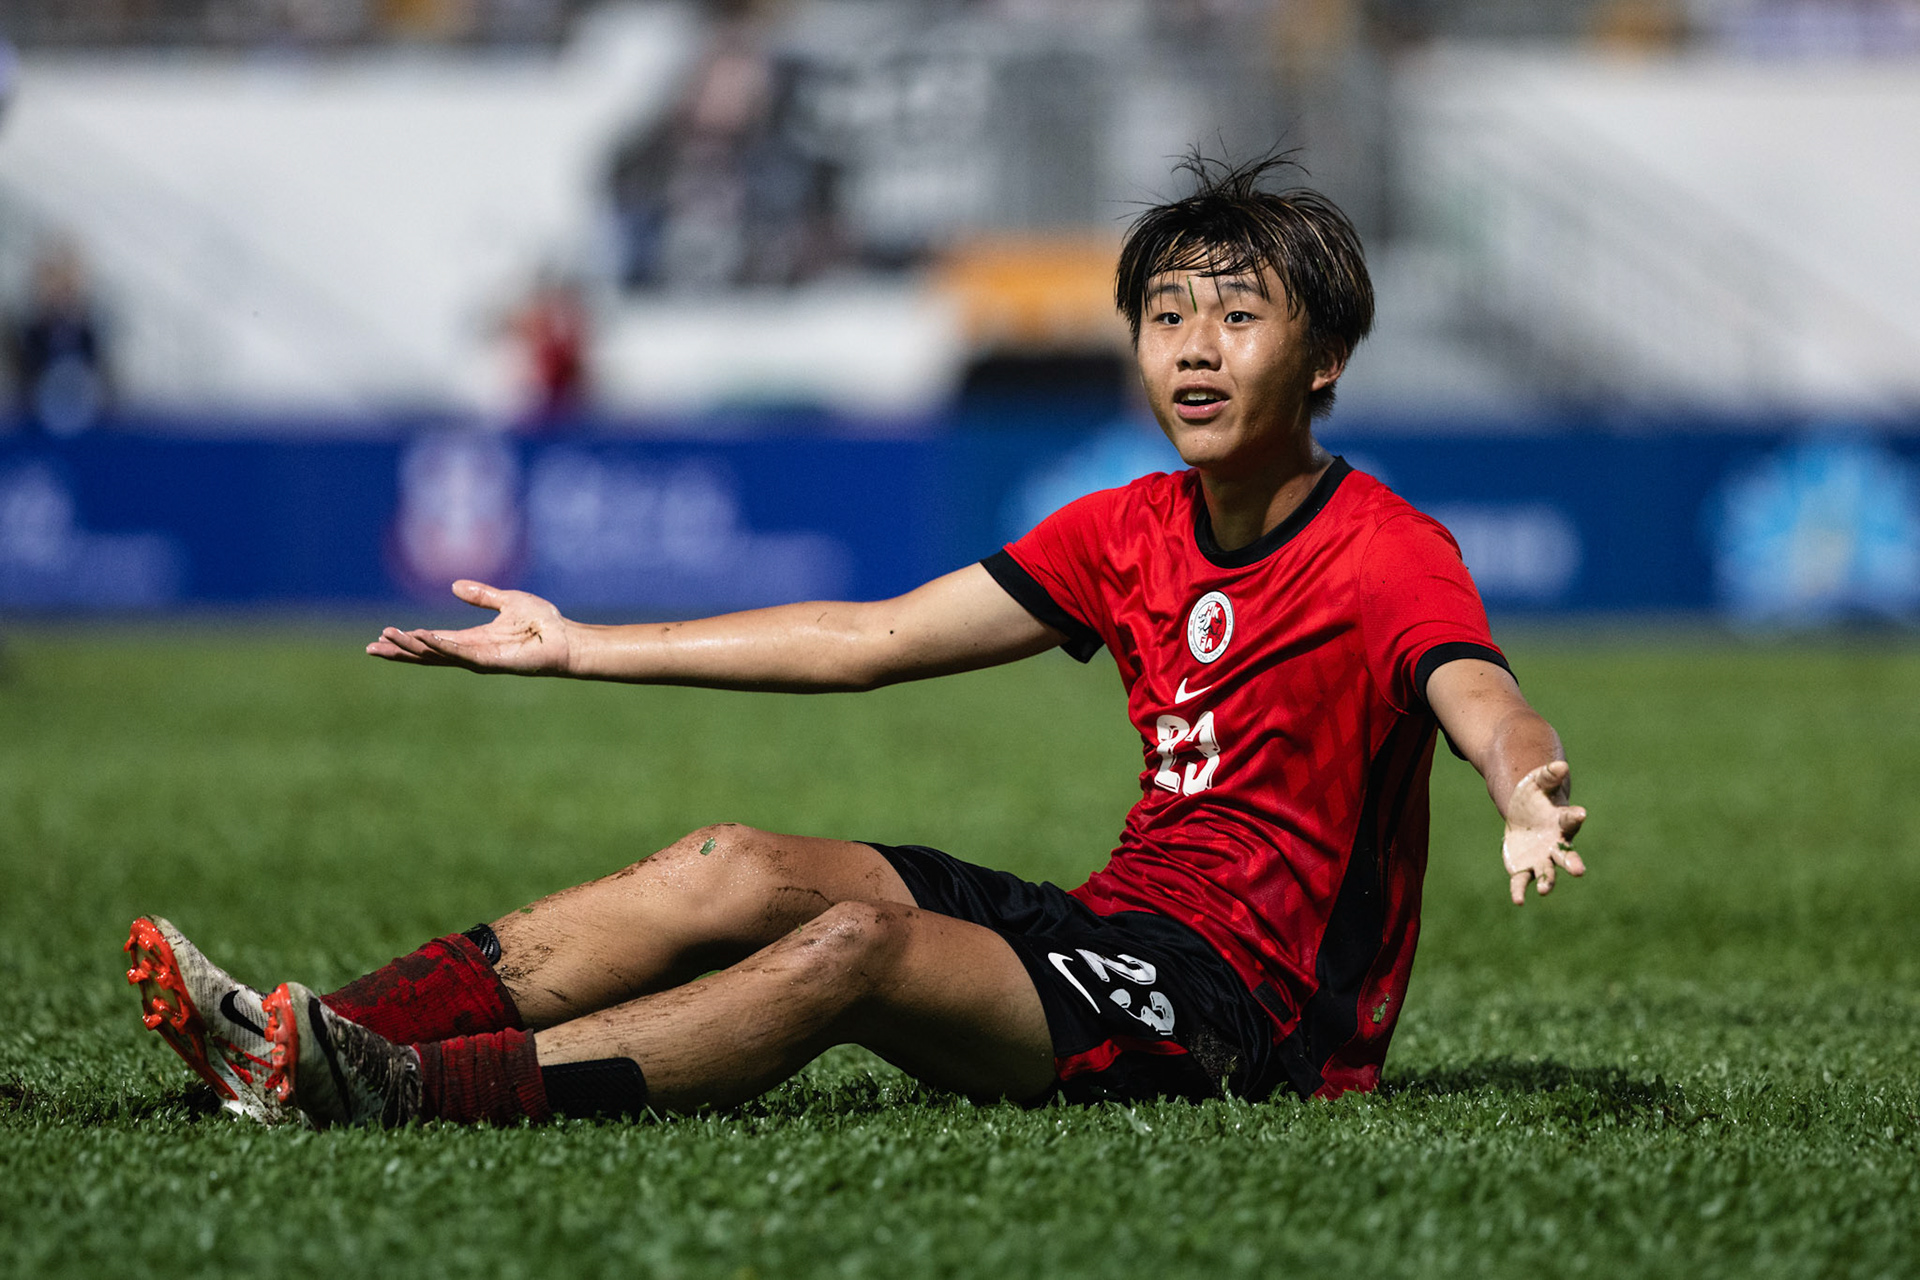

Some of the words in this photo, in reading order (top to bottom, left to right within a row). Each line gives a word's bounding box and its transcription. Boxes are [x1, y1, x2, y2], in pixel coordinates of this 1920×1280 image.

[1206, 605, 1220, 619] HK
[1200, 636, 1212, 650] FA
[1154, 710, 1221, 797] 23
[1075, 949, 1175, 1035] 23
